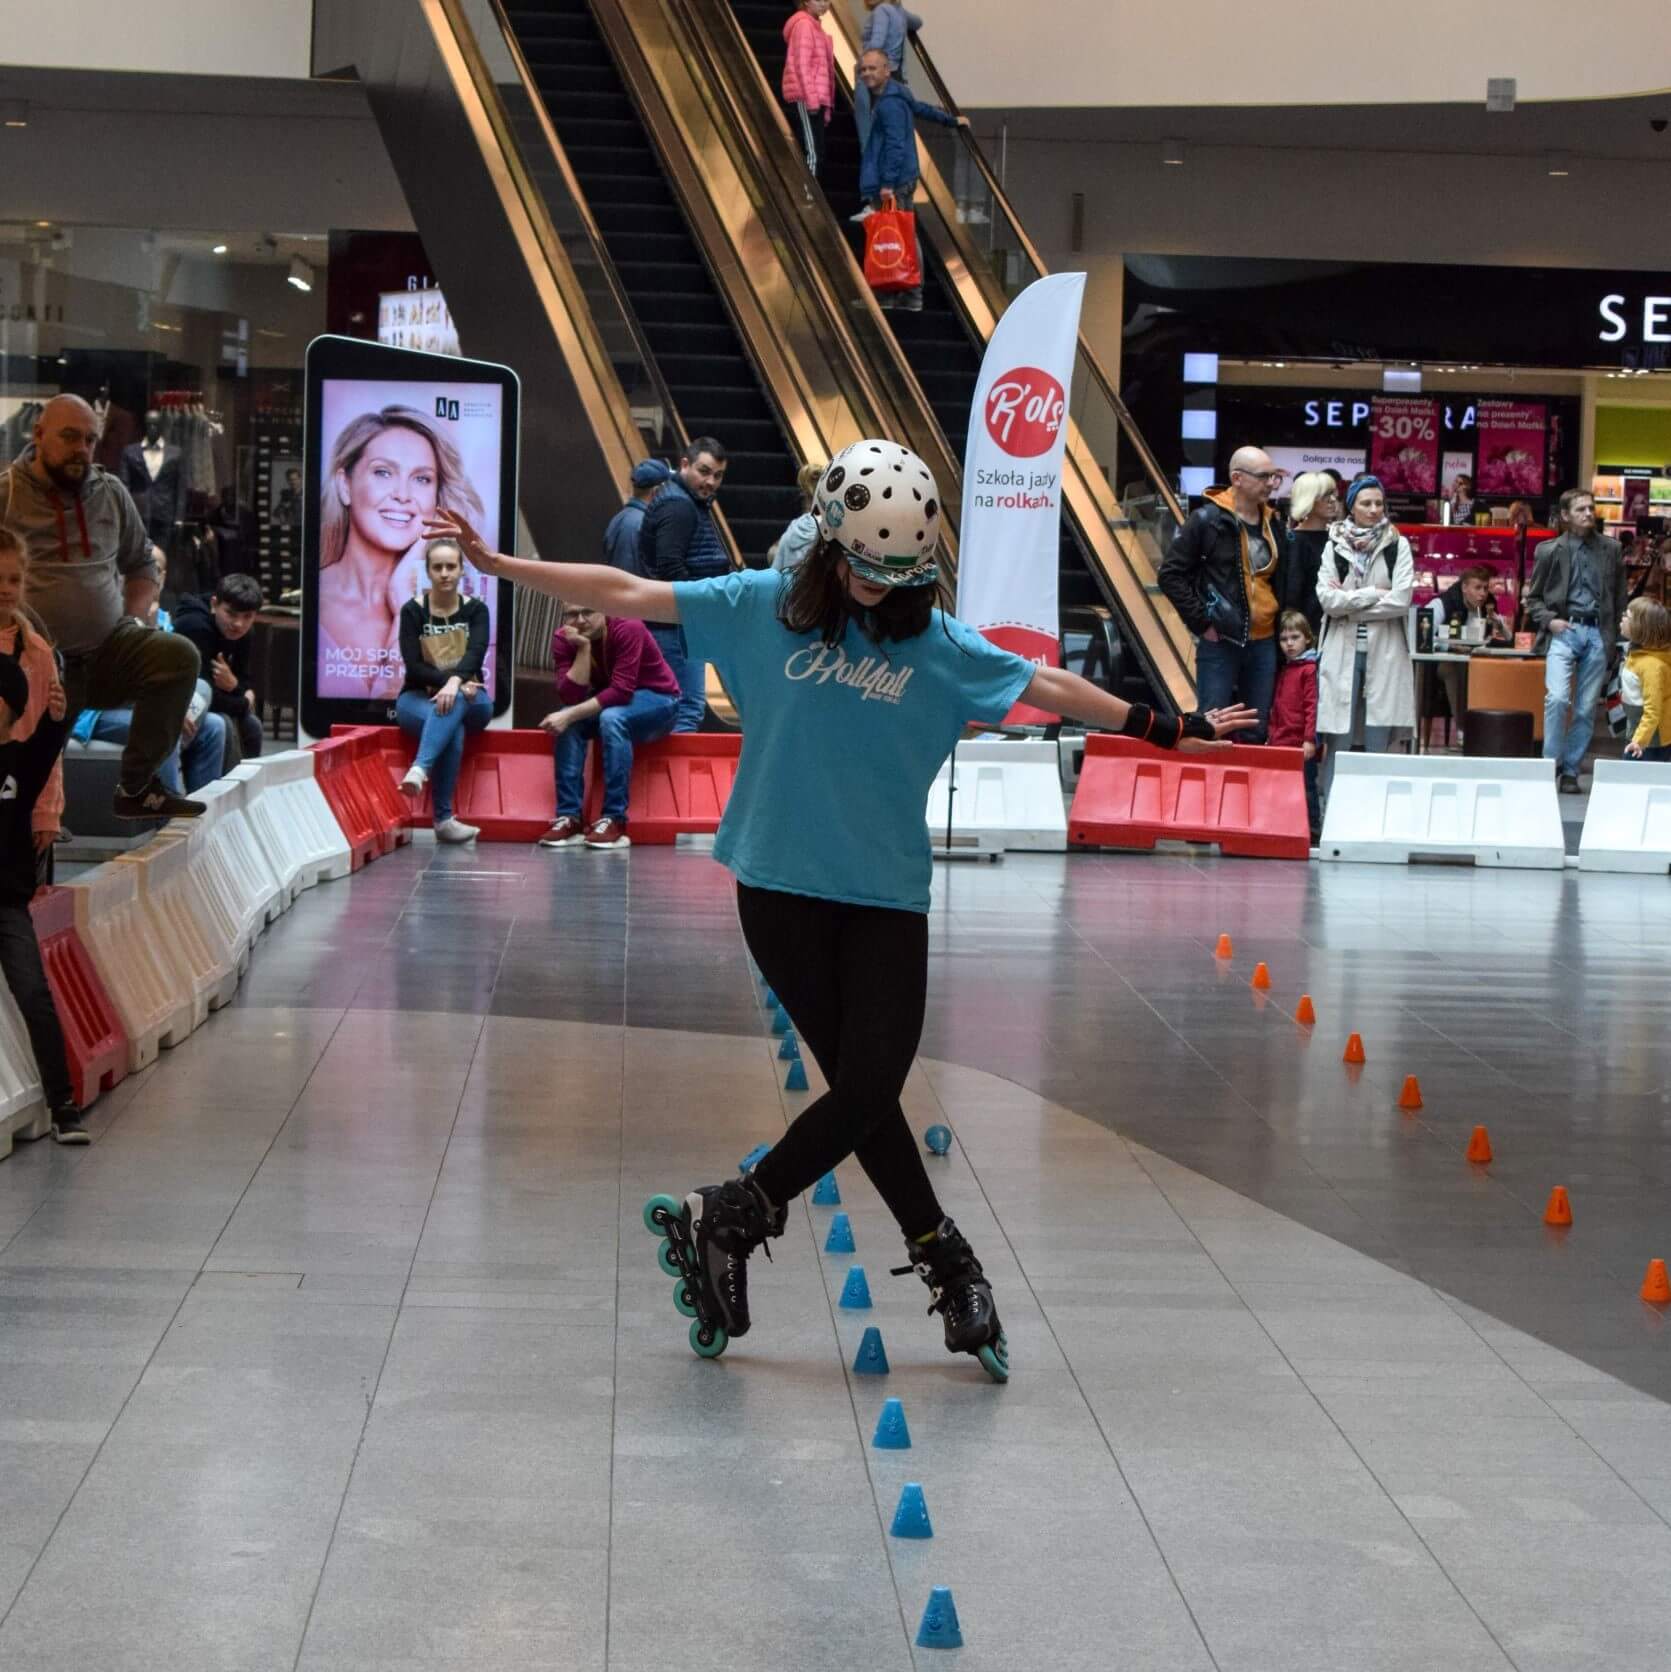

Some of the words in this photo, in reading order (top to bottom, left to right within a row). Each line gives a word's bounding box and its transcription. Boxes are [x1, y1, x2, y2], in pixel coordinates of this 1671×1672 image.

[1369, 415, 1435, 441] -30%
[1334, 456, 1345, 464] do
[976, 468, 1025, 486] Szkoła
[974, 494, 994, 508] na
[325, 664, 394, 678] PRZEPIS
